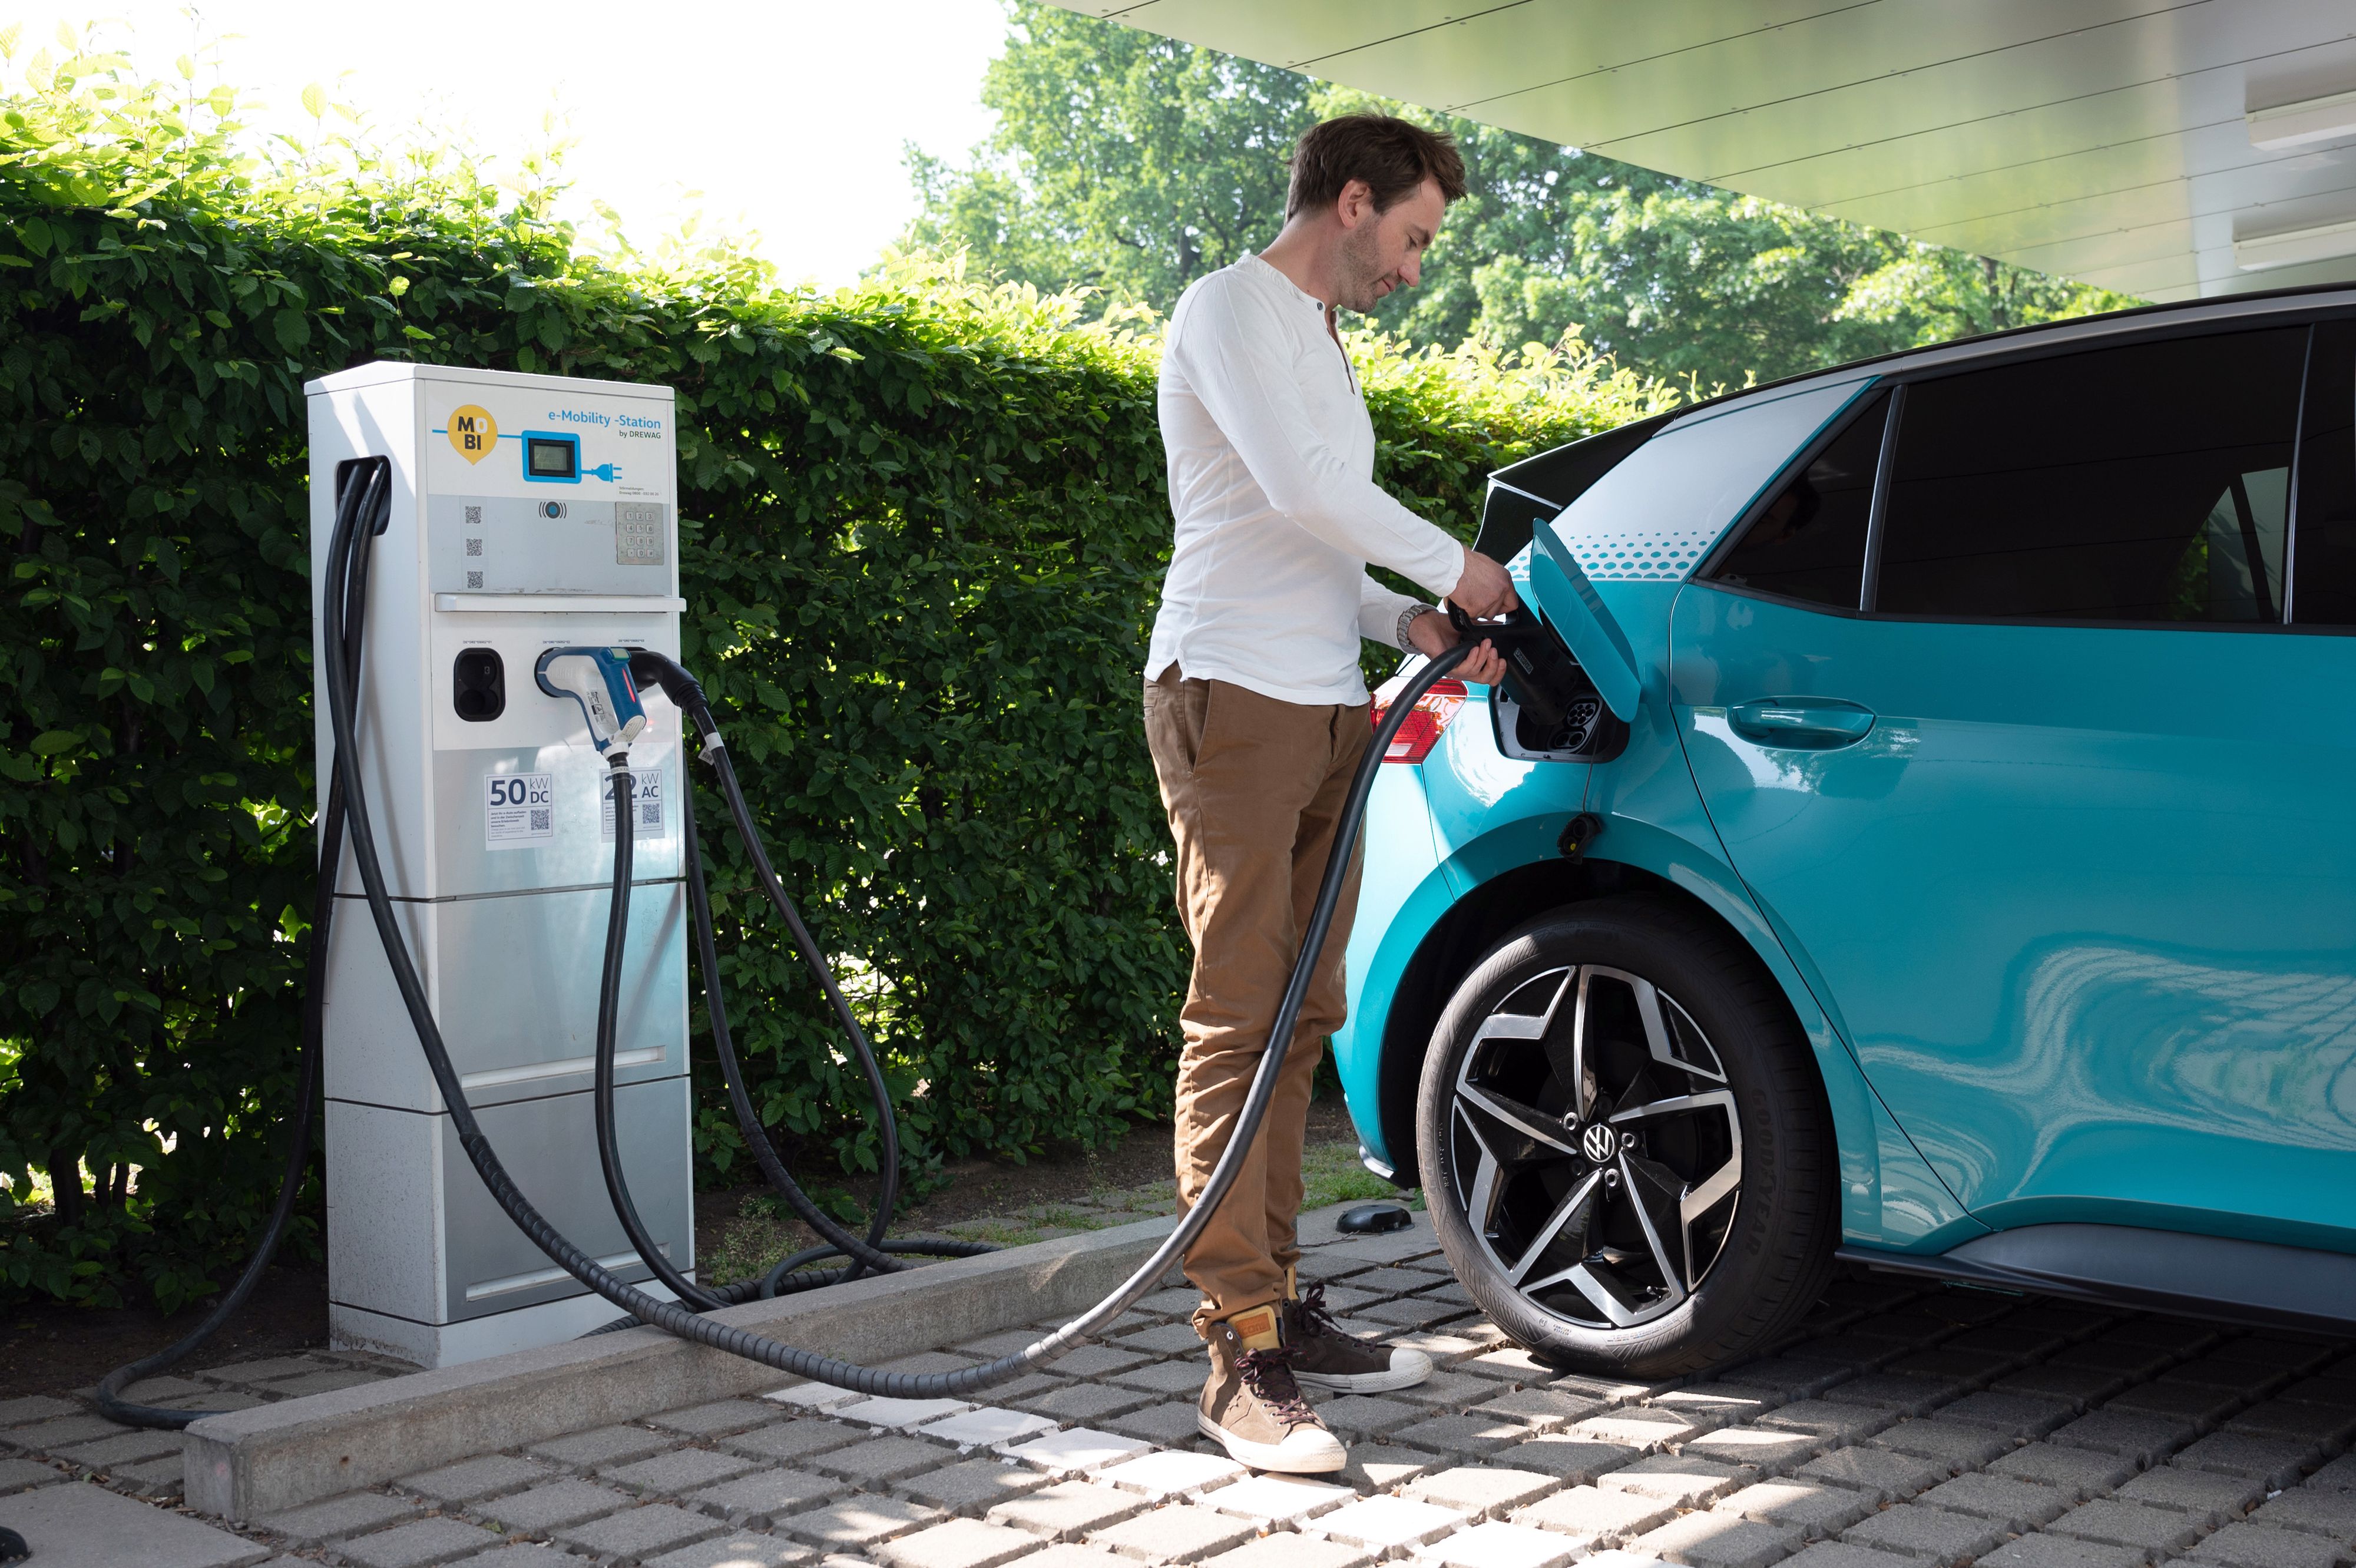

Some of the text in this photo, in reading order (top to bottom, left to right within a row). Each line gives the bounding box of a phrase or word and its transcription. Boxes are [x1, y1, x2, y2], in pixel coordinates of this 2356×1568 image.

[458, 416, 488, 434] MO
[548, 410, 610, 428] e-Mobility
[619, 430, 627, 438] by
[465, 434, 481, 450] BI
[530, 778, 548, 790] kW
[641, 773, 659, 785] kW
[490, 779, 526, 806] 50
[531, 791, 549, 803] DC
[641, 786, 659, 798] AC
